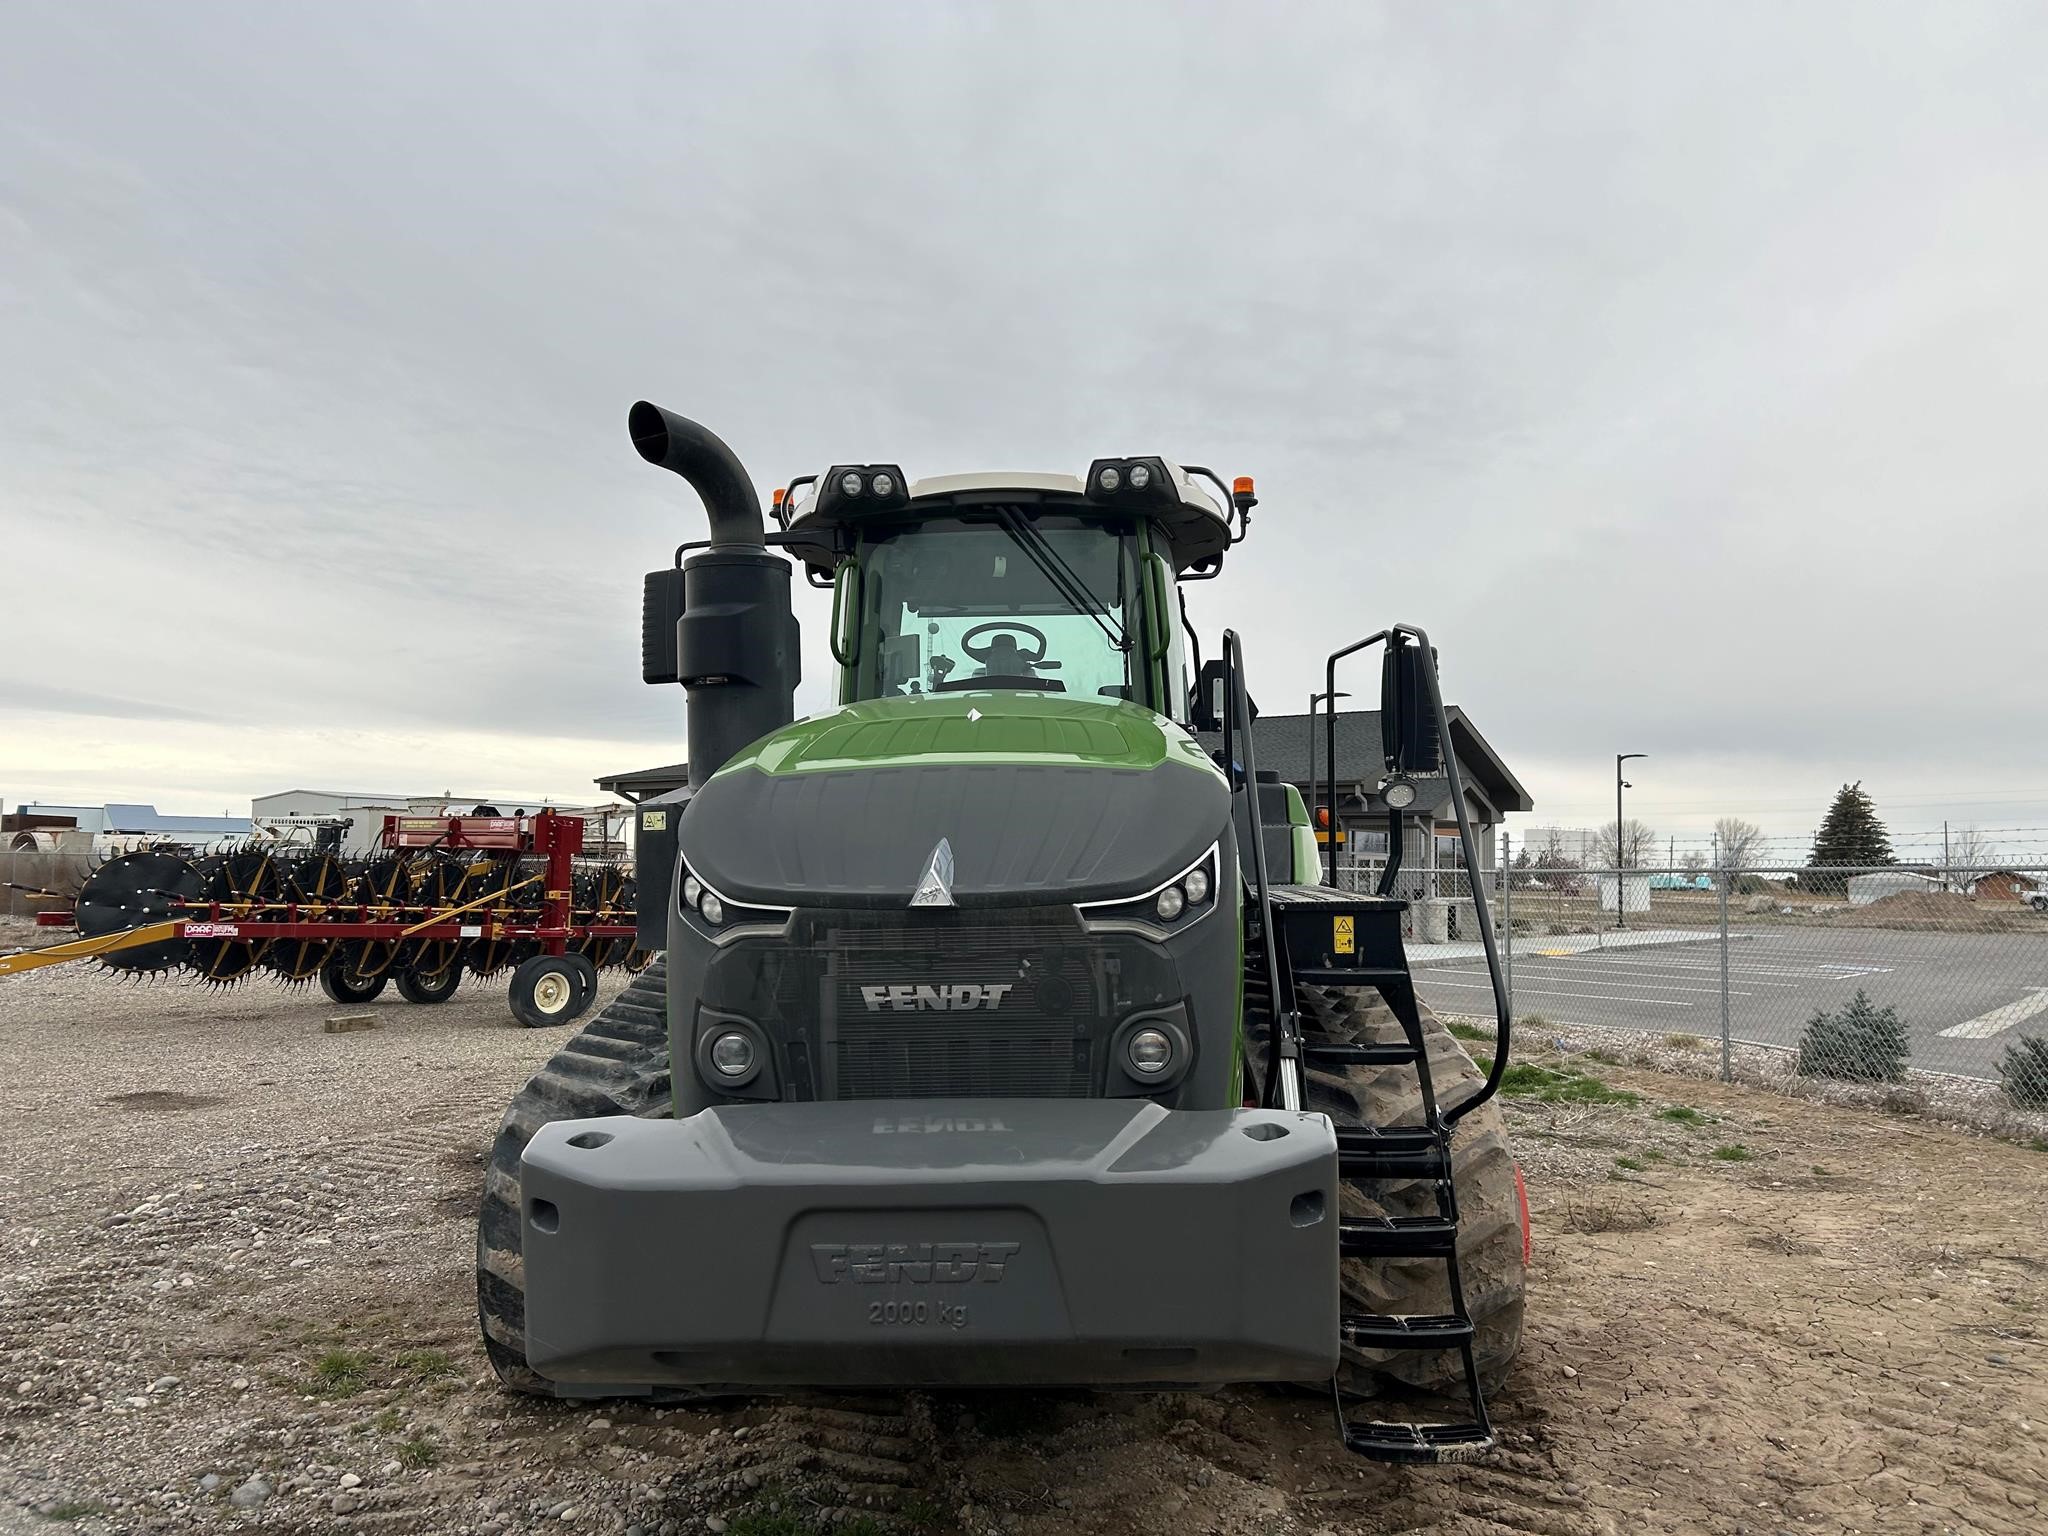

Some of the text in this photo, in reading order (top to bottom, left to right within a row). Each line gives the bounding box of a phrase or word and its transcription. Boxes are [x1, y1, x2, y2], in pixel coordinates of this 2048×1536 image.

[861, 984, 1012, 1011] FENDT
[810, 1242, 1021, 1284] FENDT
[869, 1301, 968, 1327] 2000 kg
